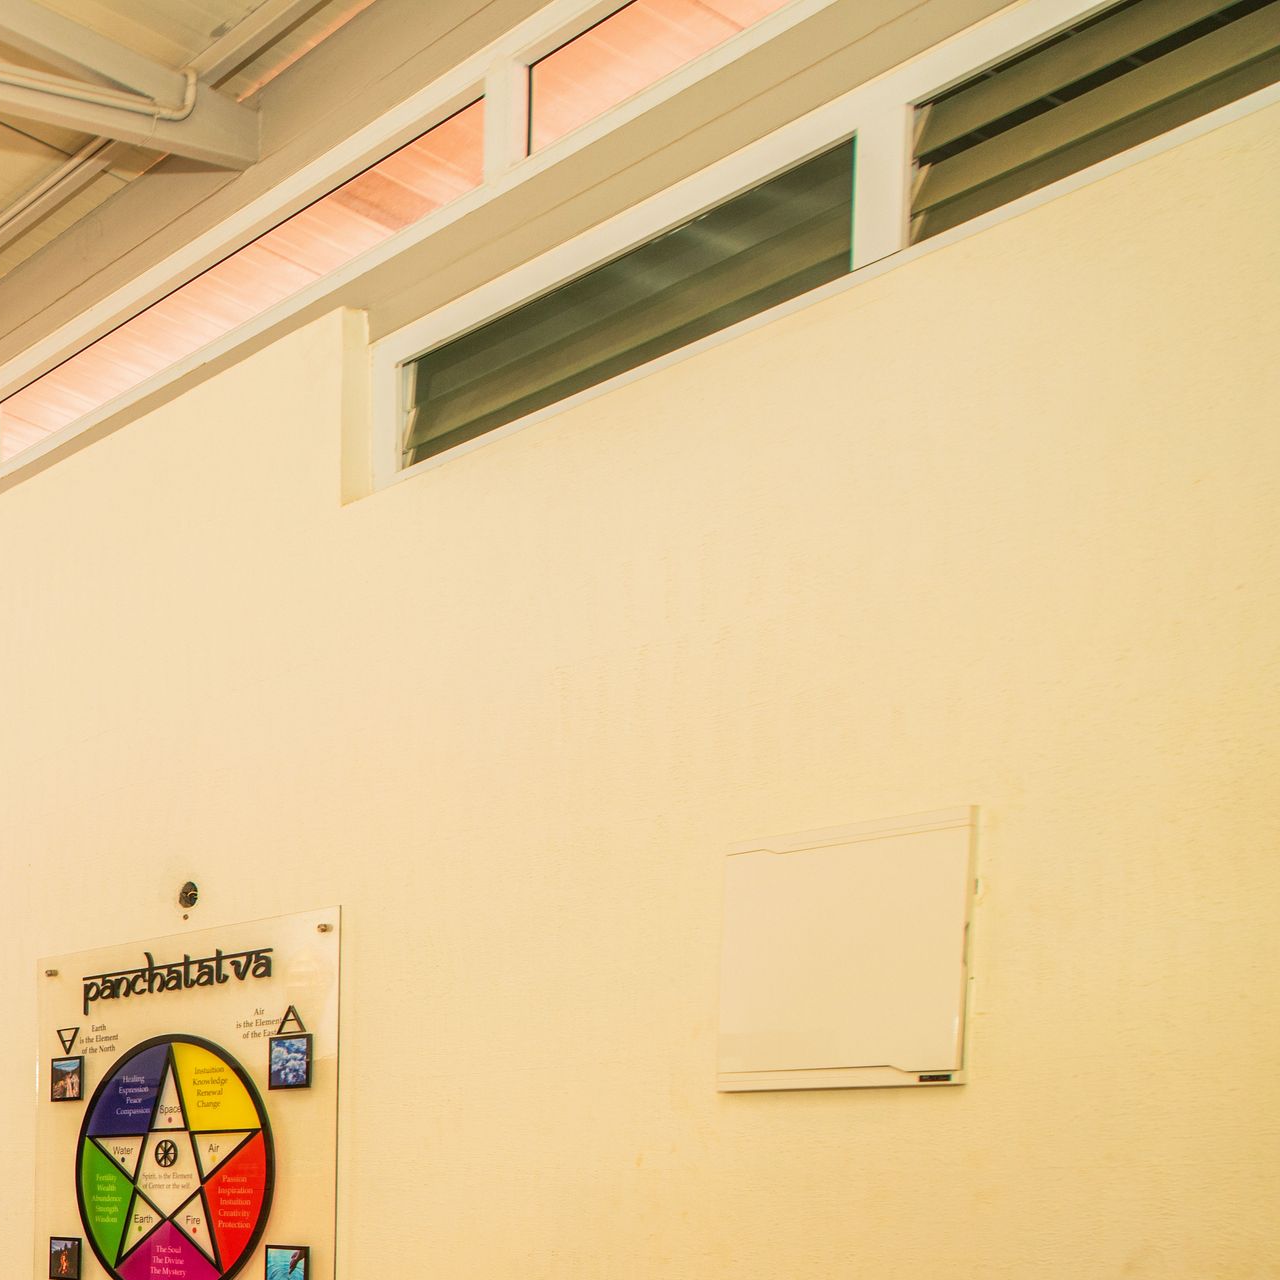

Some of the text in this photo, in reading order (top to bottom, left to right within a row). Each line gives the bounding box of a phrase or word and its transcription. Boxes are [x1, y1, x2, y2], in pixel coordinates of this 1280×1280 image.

[83, 948, 273, 1016] panchatatva
[253, 1008, 265, 1017] Air
[91, 1024, 106, 1032] Earth
[236, 1018, 282, 1029] is the Element
[95, 1034, 119, 1043] Element
[242, 1031, 250, 1040] of
[251, 1030, 261, 1038] the
[82, 1044, 116, 1054] of the North
[122, 1074, 145, 1084] Healing
[192, 1077, 228, 1088] Knowledge
[118, 1086, 149, 1096] Expression
[196, 1088, 223, 1097] Renewal
[159, 1104, 182, 1115] Space
[196, 1100, 220, 1109] Change
[116, 1107, 151, 1117] Compassion
[112, 1145, 134, 1155] Water
[208, 1143, 220, 1153] Air
[222, 1174, 247, 1183] Passion
[218, 1186, 253, 1196] Inspiration
[218, 1208, 251, 1218] Creativity
[133, 1213, 154, 1224] Earth
[185, 1214, 201, 1225] Fire
[218, 1219, 251, 1229] Protection
[156, 1245, 181, 1254] The Soul
[152, 1256, 184, 1265] The Divine
[150, 1266, 186, 1278] The Mystery
